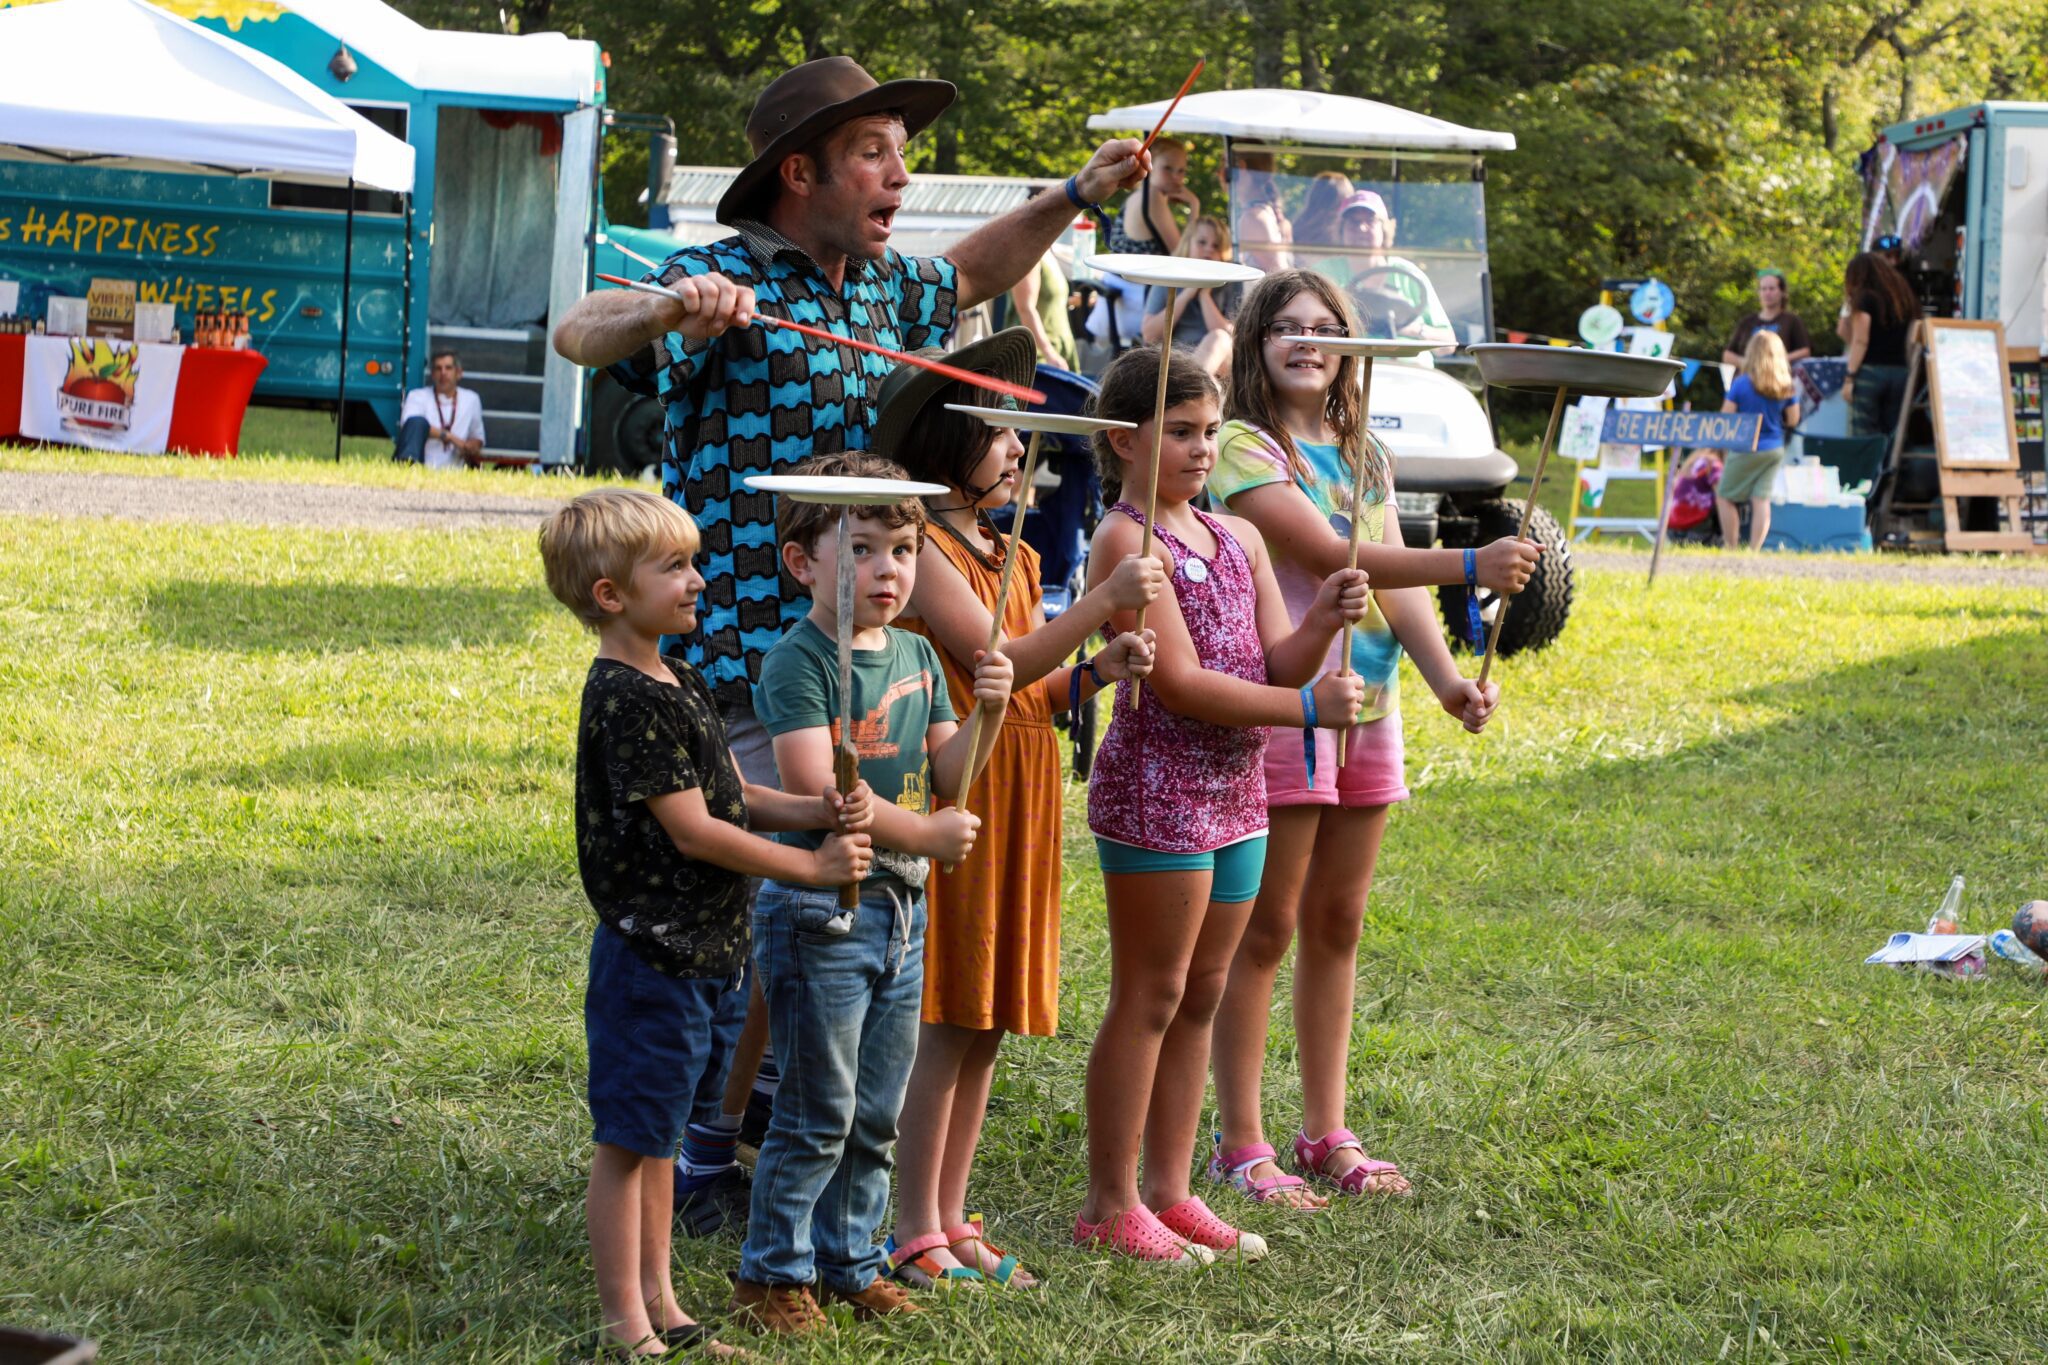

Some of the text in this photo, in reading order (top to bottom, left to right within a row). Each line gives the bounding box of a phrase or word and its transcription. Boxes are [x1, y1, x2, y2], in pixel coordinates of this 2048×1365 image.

[21, 206, 220, 257] HAPPINESS
[140, 276, 278, 322] WHEELS
[61, 396, 123, 421] PURE FIRE
[1616, 411, 1742, 442] BE HERE NOW
